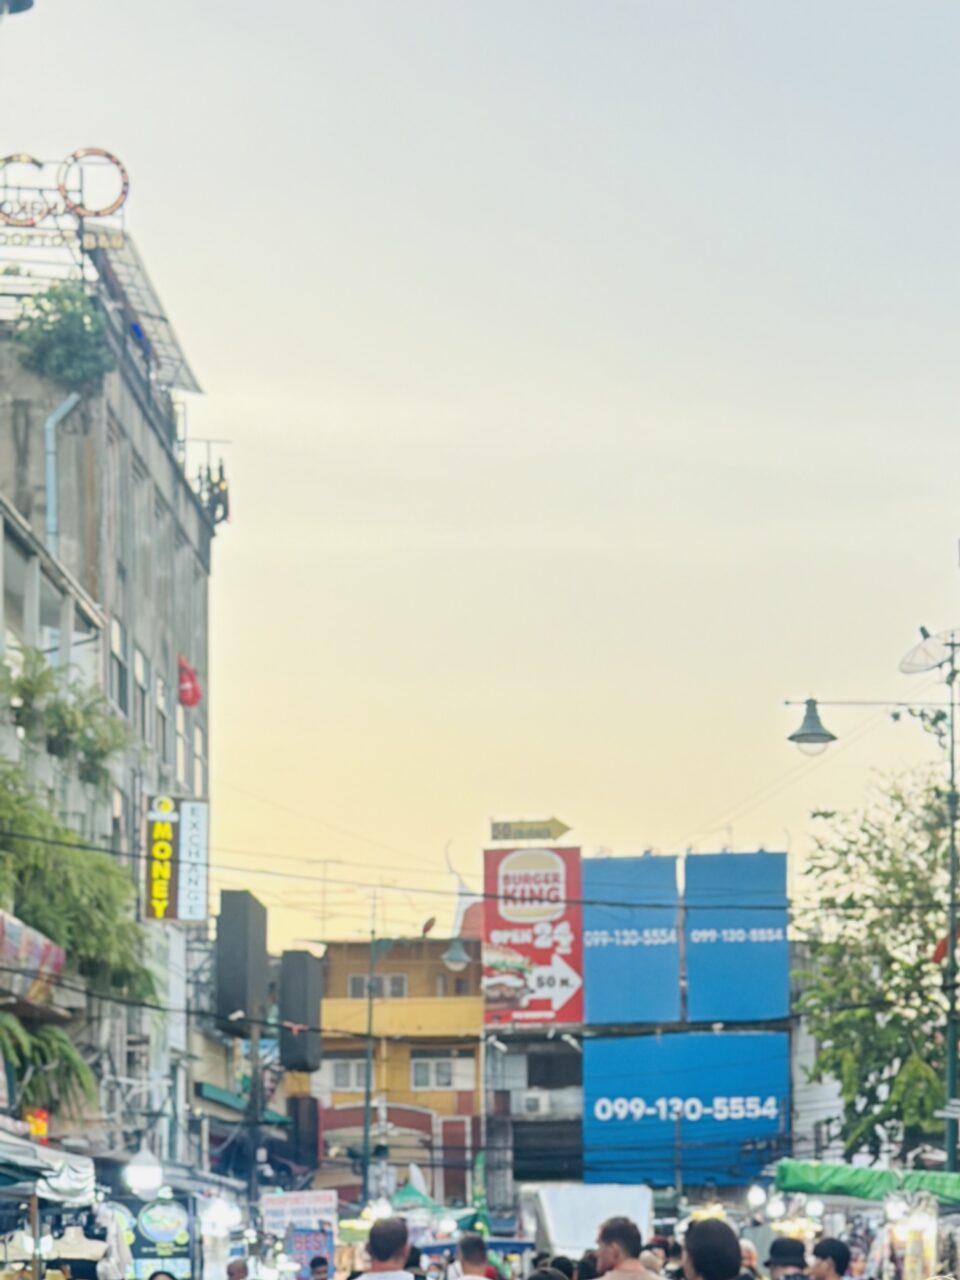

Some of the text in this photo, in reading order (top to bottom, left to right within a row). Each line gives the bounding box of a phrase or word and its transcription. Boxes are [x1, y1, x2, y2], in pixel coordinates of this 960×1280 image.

[151, 820, 173, 919] MONEY
[187, 806, 200, 915] EXCHANGE
[503, 872, 560, 885] BURGER
[503, 887, 560, 906] KING
[490, 921, 574, 949] OPEN 24
[594, 1096, 779, 1121] 099-130-5554
